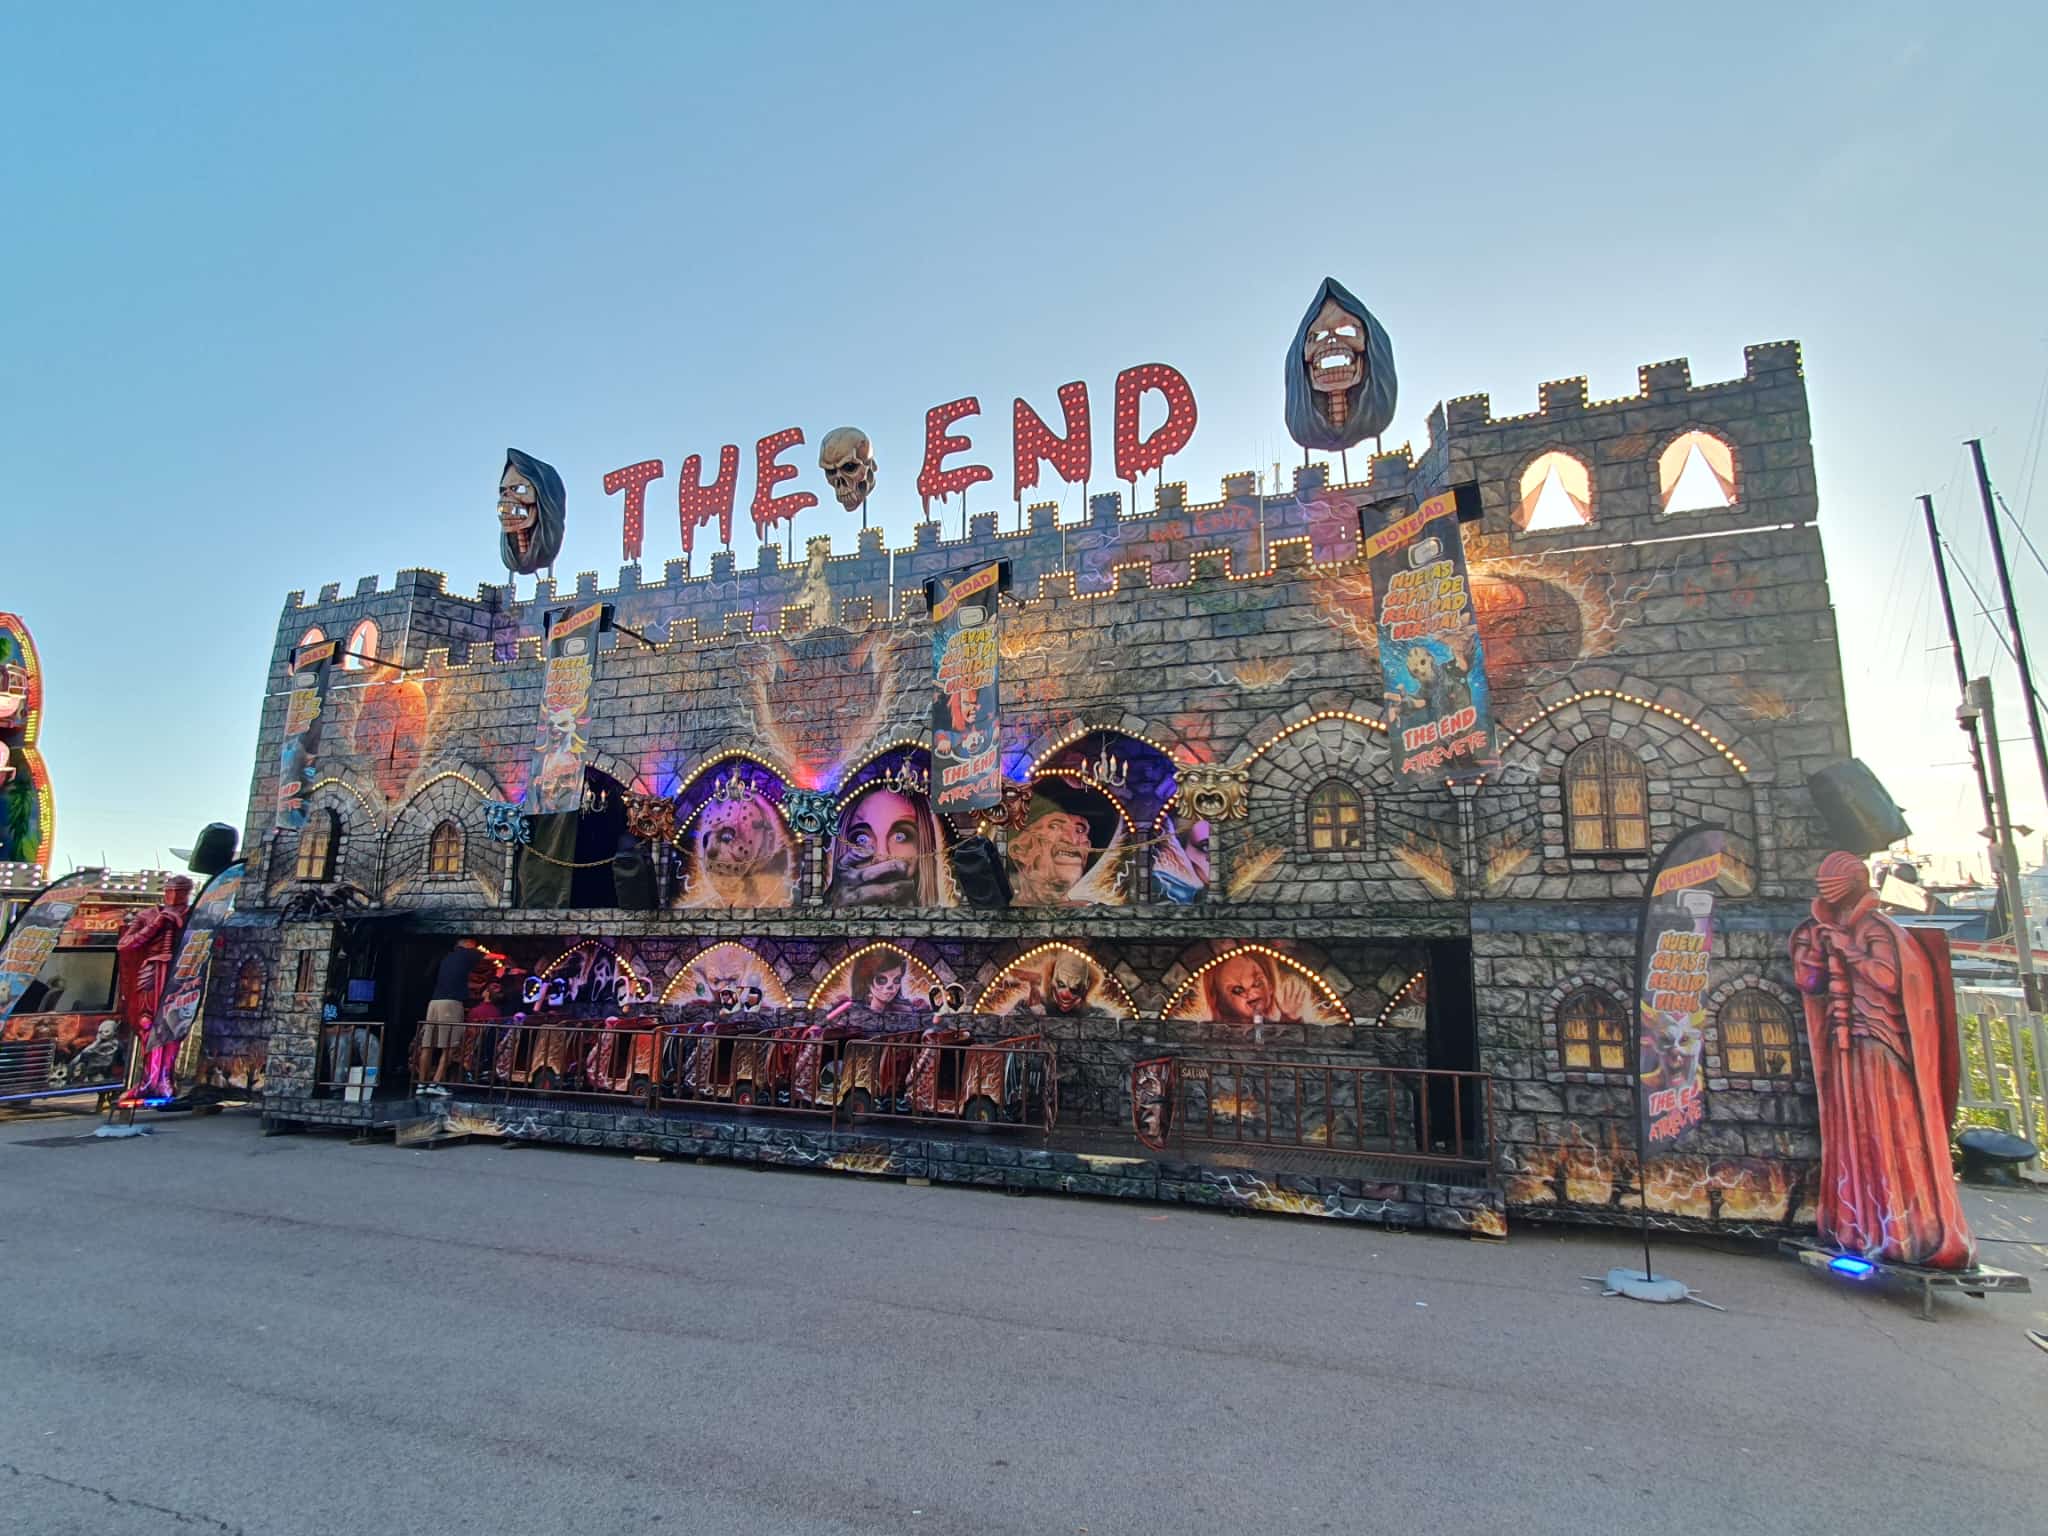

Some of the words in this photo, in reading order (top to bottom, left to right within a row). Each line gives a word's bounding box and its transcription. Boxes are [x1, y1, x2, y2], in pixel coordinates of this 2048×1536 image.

[603, 427, 818, 561] THE
[917, 363, 1198, 516] END
[1375, 502, 1445, 549] NOVEDAD
[1439, 577, 1463, 595] DE
[1403, 723, 1437, 750] THE
[1439, 707, 1476, 737] END
[943, 763, 970, 786] THE
[84, 919, 118, 930] END
[1649, 1089, 1676, 1116] THE
